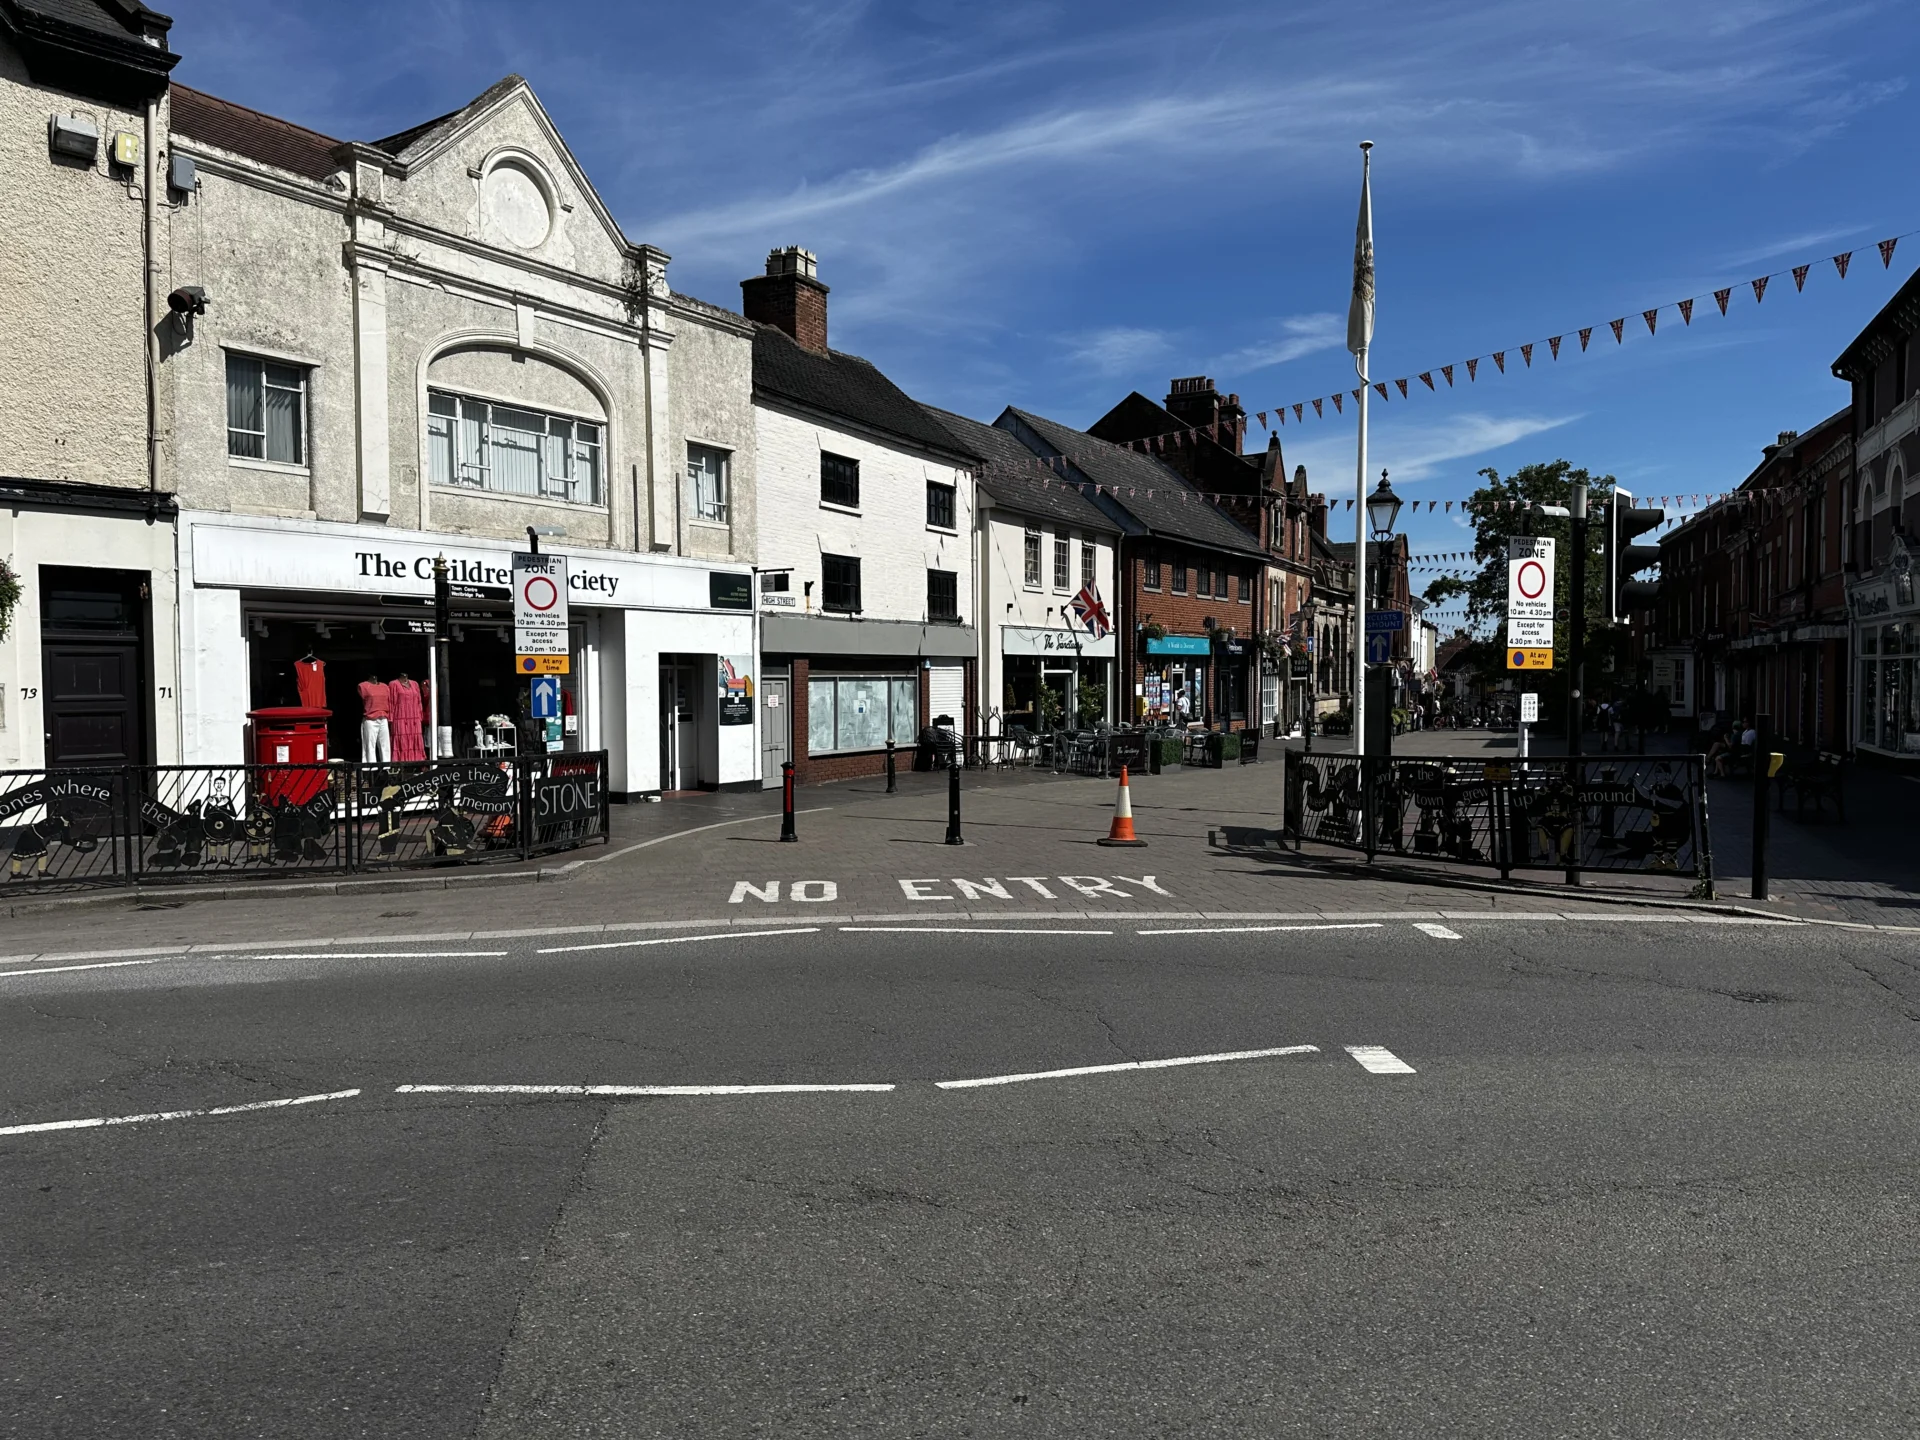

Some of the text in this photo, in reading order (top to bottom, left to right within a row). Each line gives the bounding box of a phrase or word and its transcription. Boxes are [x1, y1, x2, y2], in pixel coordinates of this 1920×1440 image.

[1514, 538, 1552, 546] PEDESTRIAN
[518, 555, 562, 564] PEDESTRIAN
[1518, 548, 1546, 558] ZONE
[355, 552, 406, 578] The
[567, 570, 619, 597] ciety
[524, 564, 556, 574] ZONE
[1044, 634, 1054, 650] The
[20, 688, 37, 700] 73
[159, 687, 172, 698] 71
[468, 768, 500, 783] their
[1376, 766, 1434, 786] and the
[51, 779, 110, 800] where
[1416, 788, 1489, 806] town grew
[362, 792, 378, 805] To
[462, 796, 514, 813] memory
[539, 781, 595, 816] STONE
[1513, 787, 1636, 809] up around
[141, 793, 332, 827] they fell
[728, 875, 1176, 903] NO ENTRY
